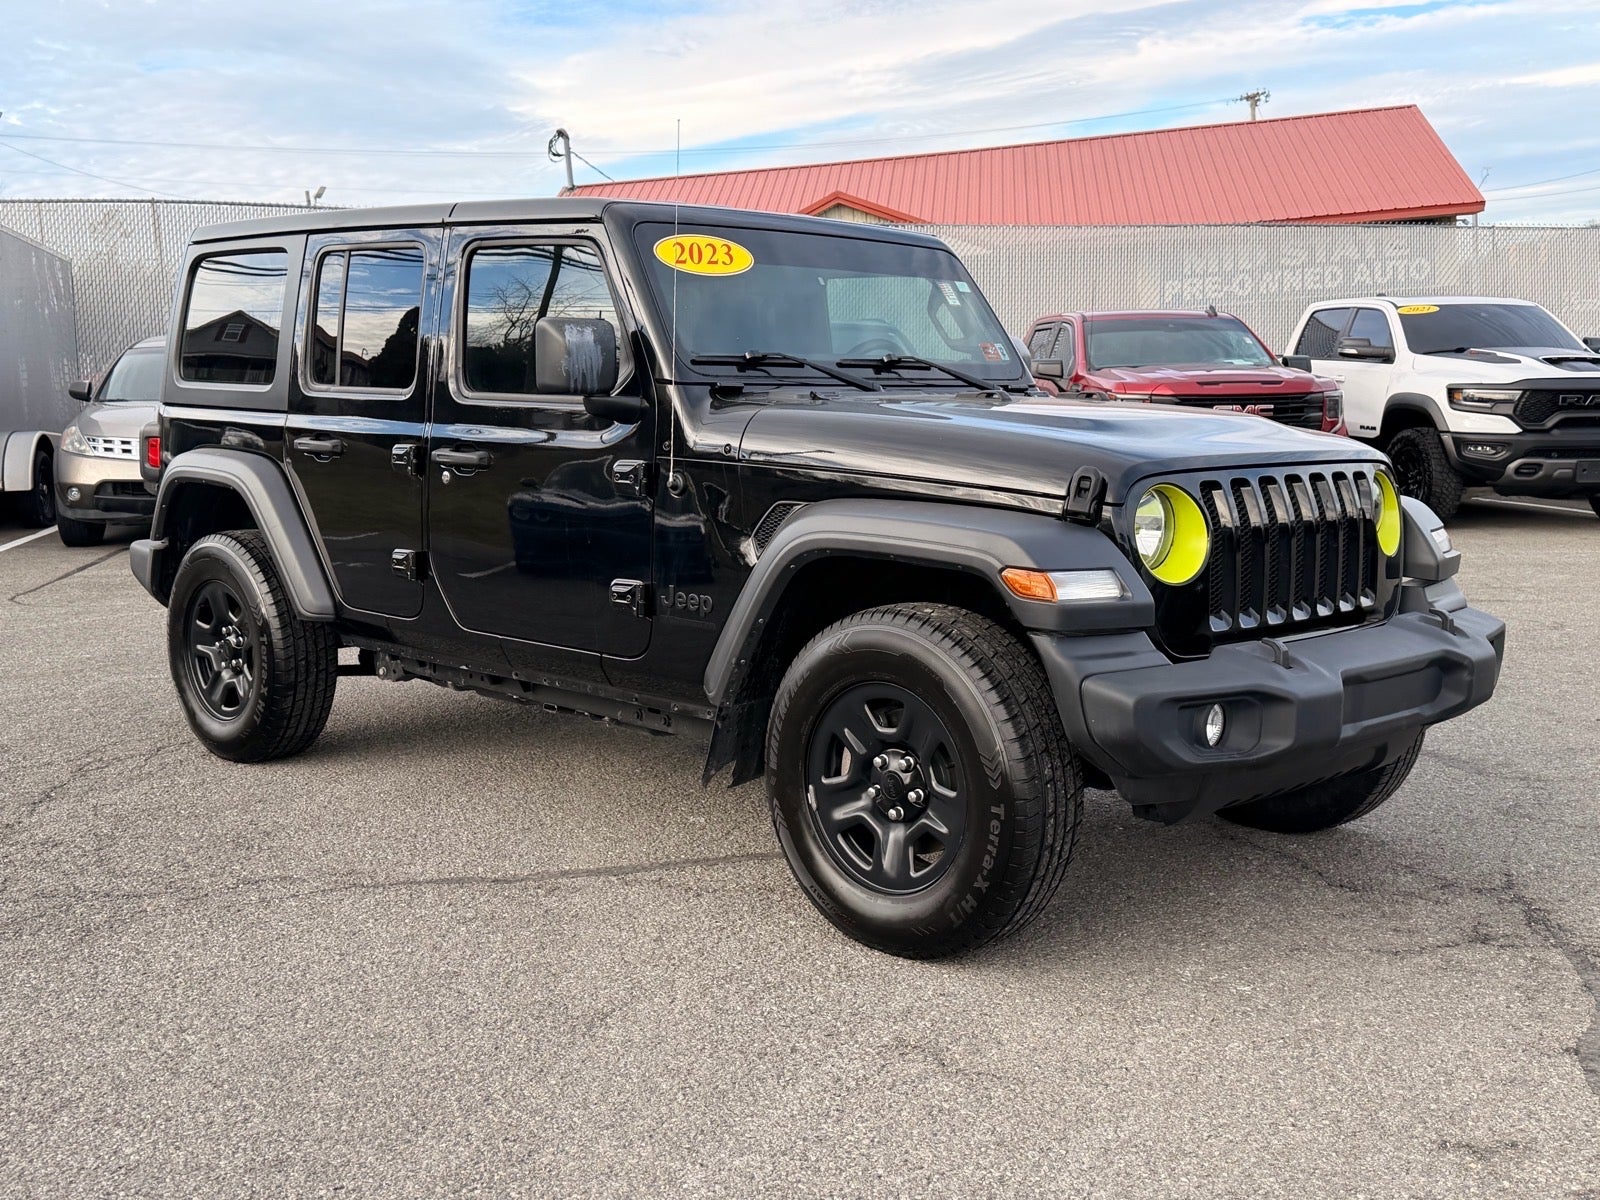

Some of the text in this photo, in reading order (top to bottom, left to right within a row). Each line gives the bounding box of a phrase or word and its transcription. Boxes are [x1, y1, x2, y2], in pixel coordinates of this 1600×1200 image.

[672, 242, 734, 266] 2023
[1352, 257, 1431, 287] AUTO
[660, 584, 713, 618] Jeep
